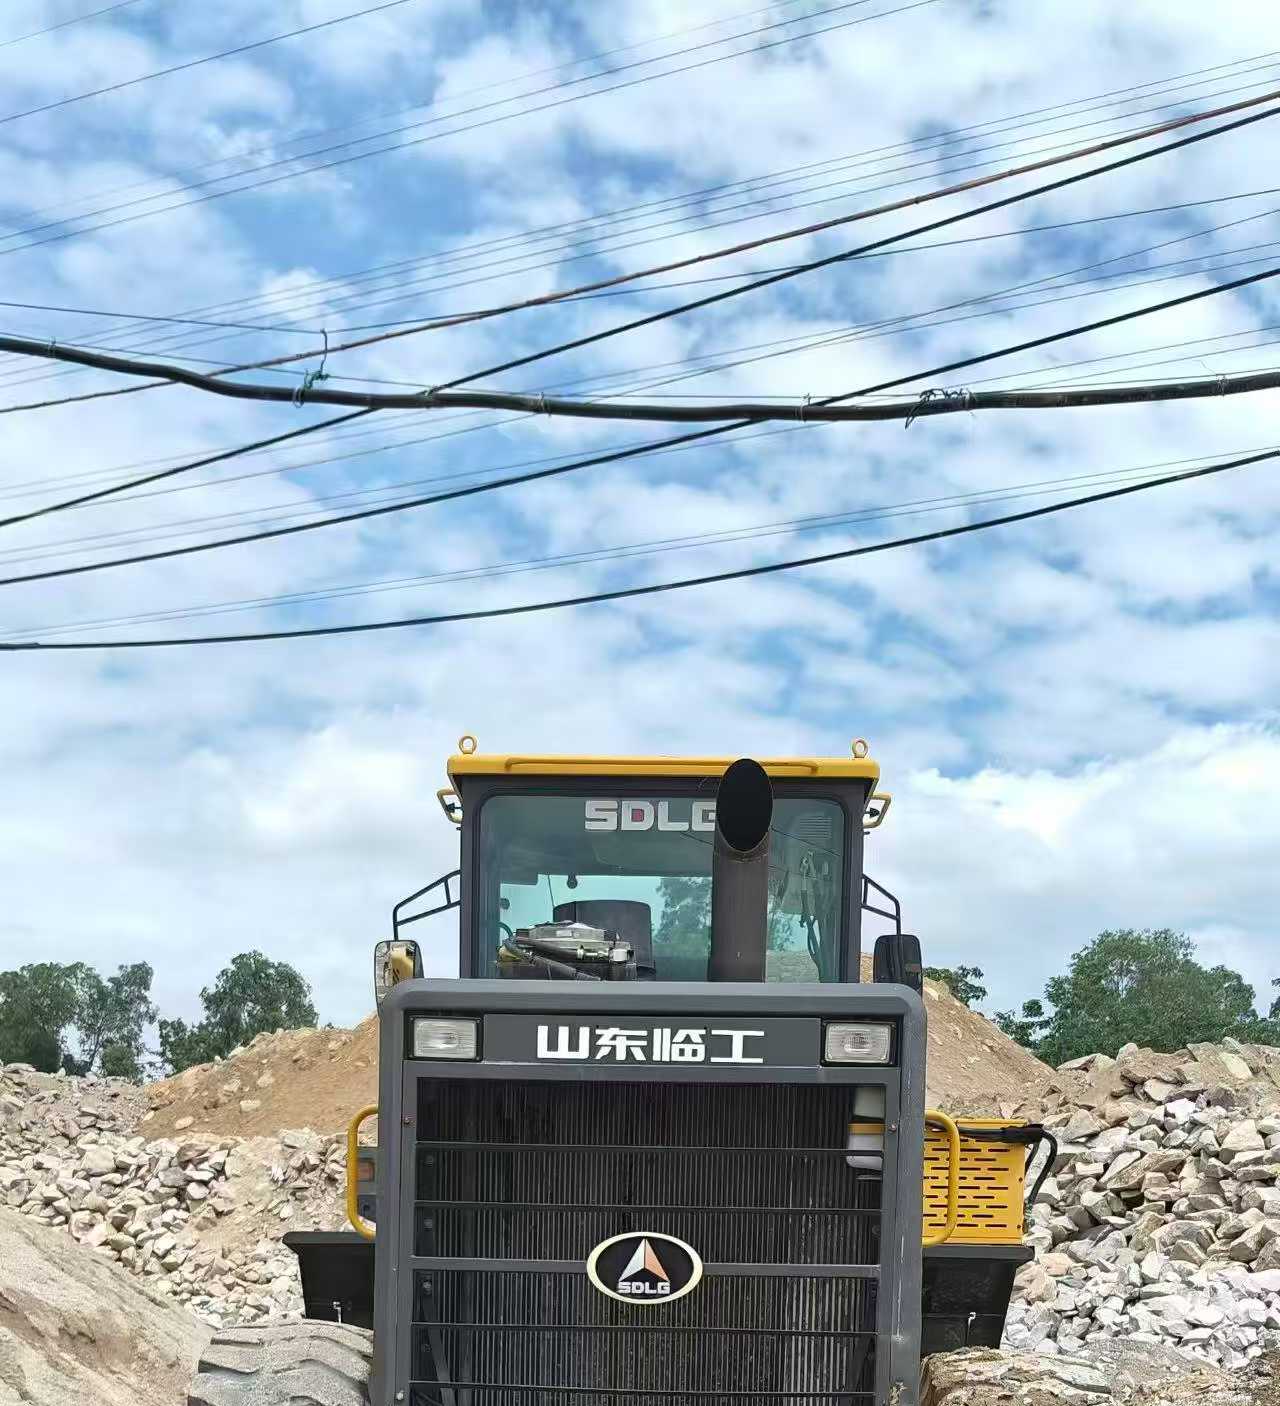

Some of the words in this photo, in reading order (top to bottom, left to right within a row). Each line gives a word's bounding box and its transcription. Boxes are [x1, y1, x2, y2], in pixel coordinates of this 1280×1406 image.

[537, 1025, 764, 1063] 山东临工
[618, 1281, 670, 1294] SDLG
